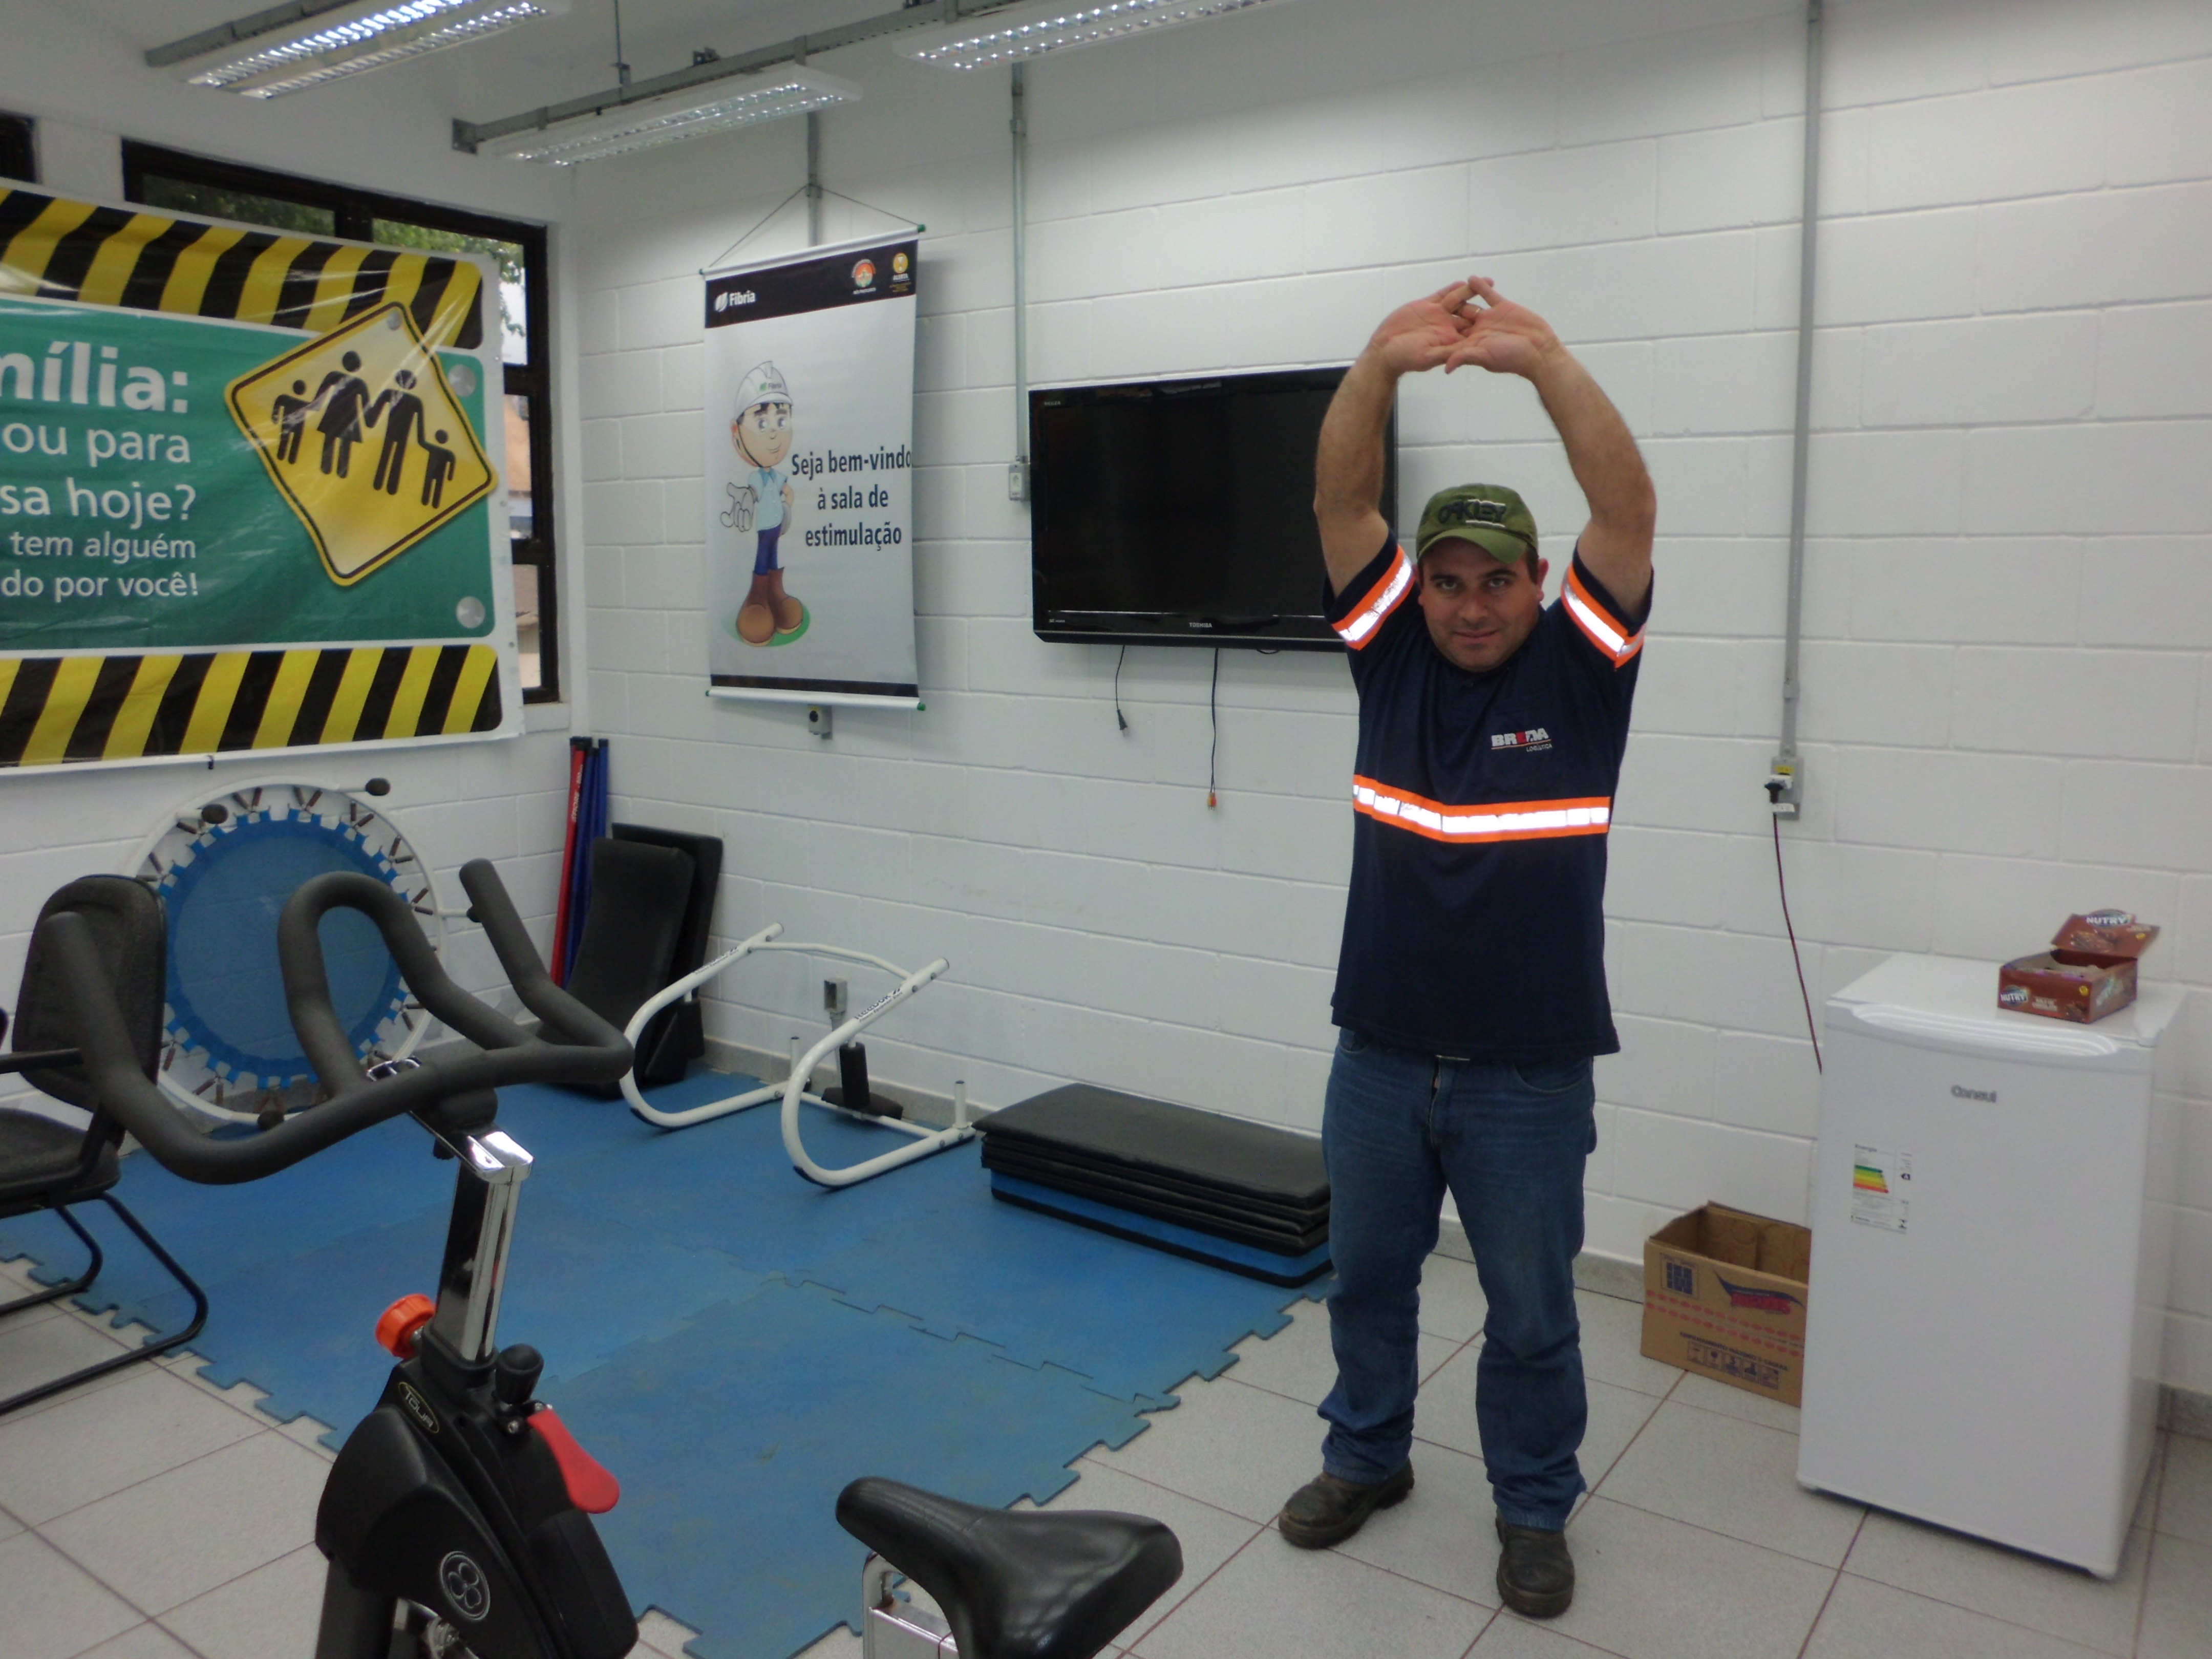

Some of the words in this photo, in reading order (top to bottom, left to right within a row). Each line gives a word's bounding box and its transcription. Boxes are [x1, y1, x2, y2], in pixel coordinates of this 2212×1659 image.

[729, 290, 756, 306] Fibria
[3, 422, 68, 455] ou
[87, 428, 190, 467] para
[792, 451, 823, 480] Seja
[828, 444, 911, 473] bem-vindo
[0, 484, 50, 515] sa
[67, 477, 196, 529] hoje?
[818, 487, 826, 510] à
[831, 485, 863, 509] sala
[868, 484, 888, 508] de
[9, 531, 73, 557] tem
[83, 530, 197, 564] alguém
[805, 521, 902, 551] estimulação
[1, 568, 44, 597] do
[54, 576, 109, 603] por
[116, 571, 198, 597] você!
[405, 1386, 434, 1428] TOUR
